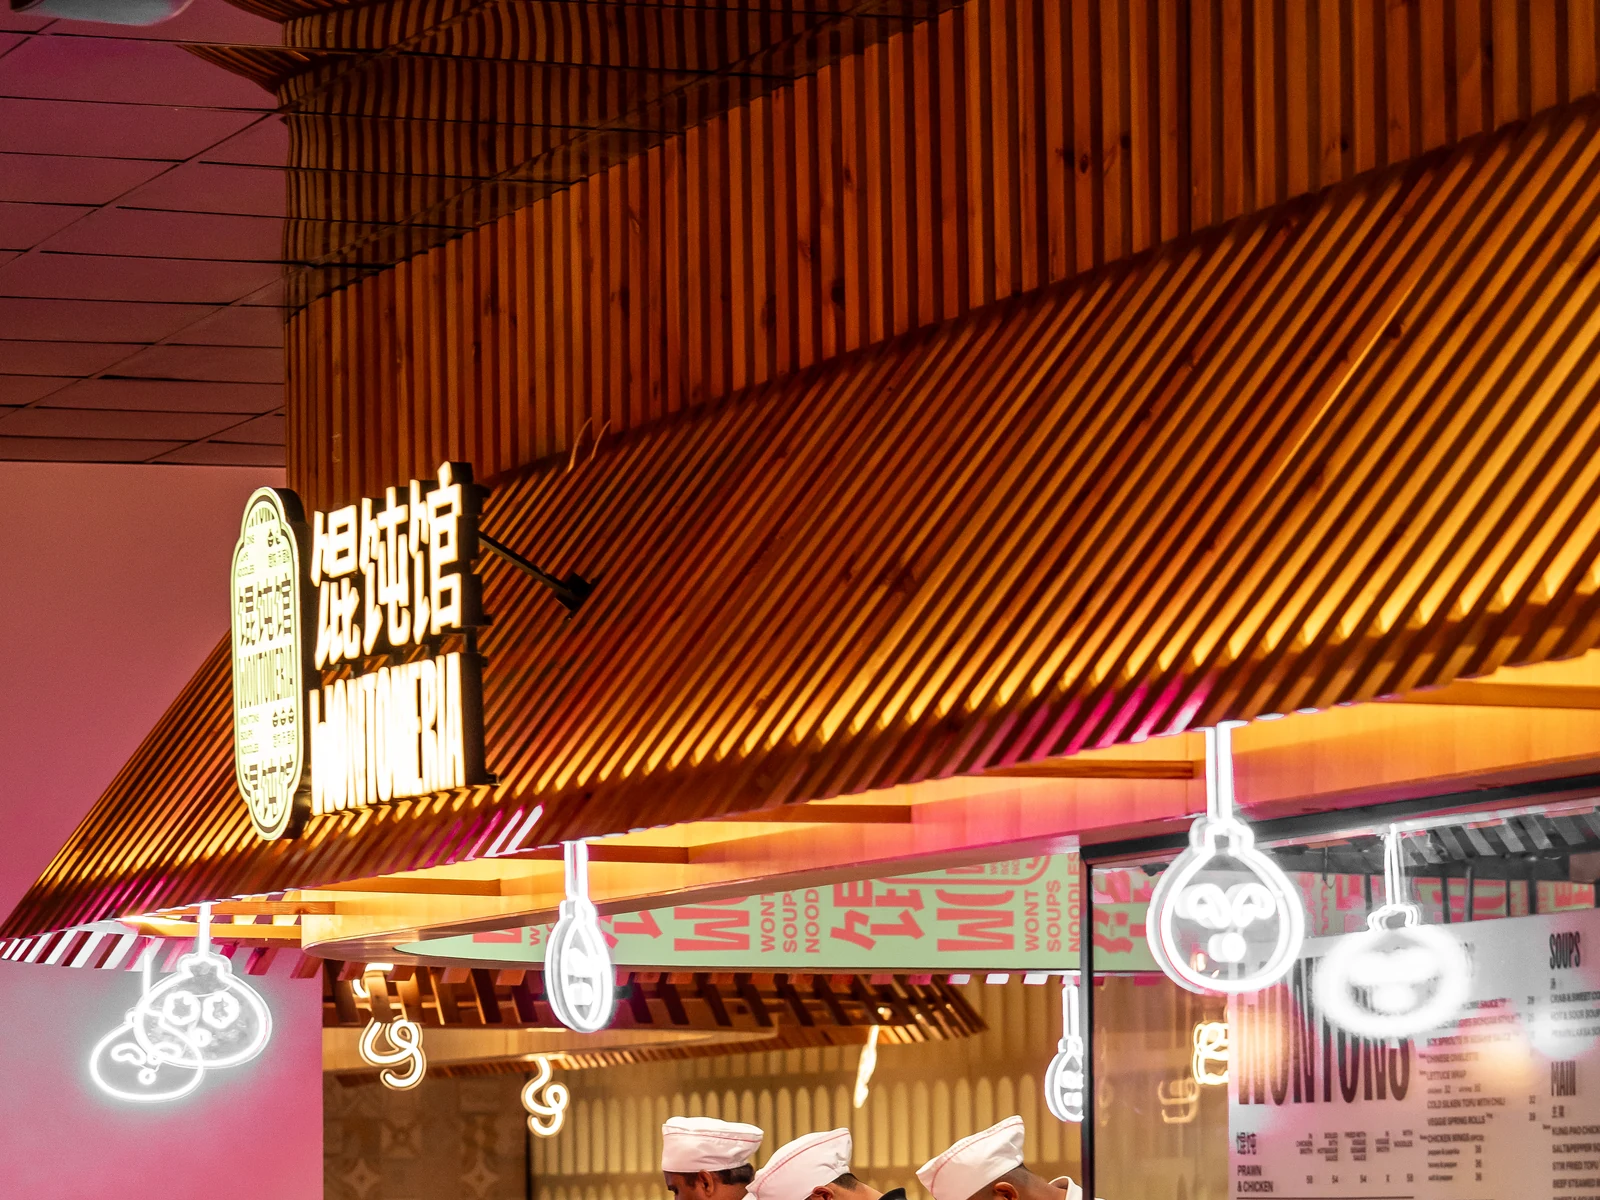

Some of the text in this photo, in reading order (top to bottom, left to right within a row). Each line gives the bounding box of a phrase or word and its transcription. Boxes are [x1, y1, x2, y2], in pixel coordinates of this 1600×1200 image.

[310, 461, 463, 671] 馄饨馆
[309, 651, 466, 816] WONTONERIA
[1045, 879, 1062, 952] SOUPS
[1549, 931, 1581, 970] SOUPS
[1551, 1061, 1576, 1097] MAIN
[1237, 1165, 1262, 1177] PRAWN
[1243, 1181, 1274, 1193] CHICKEN
